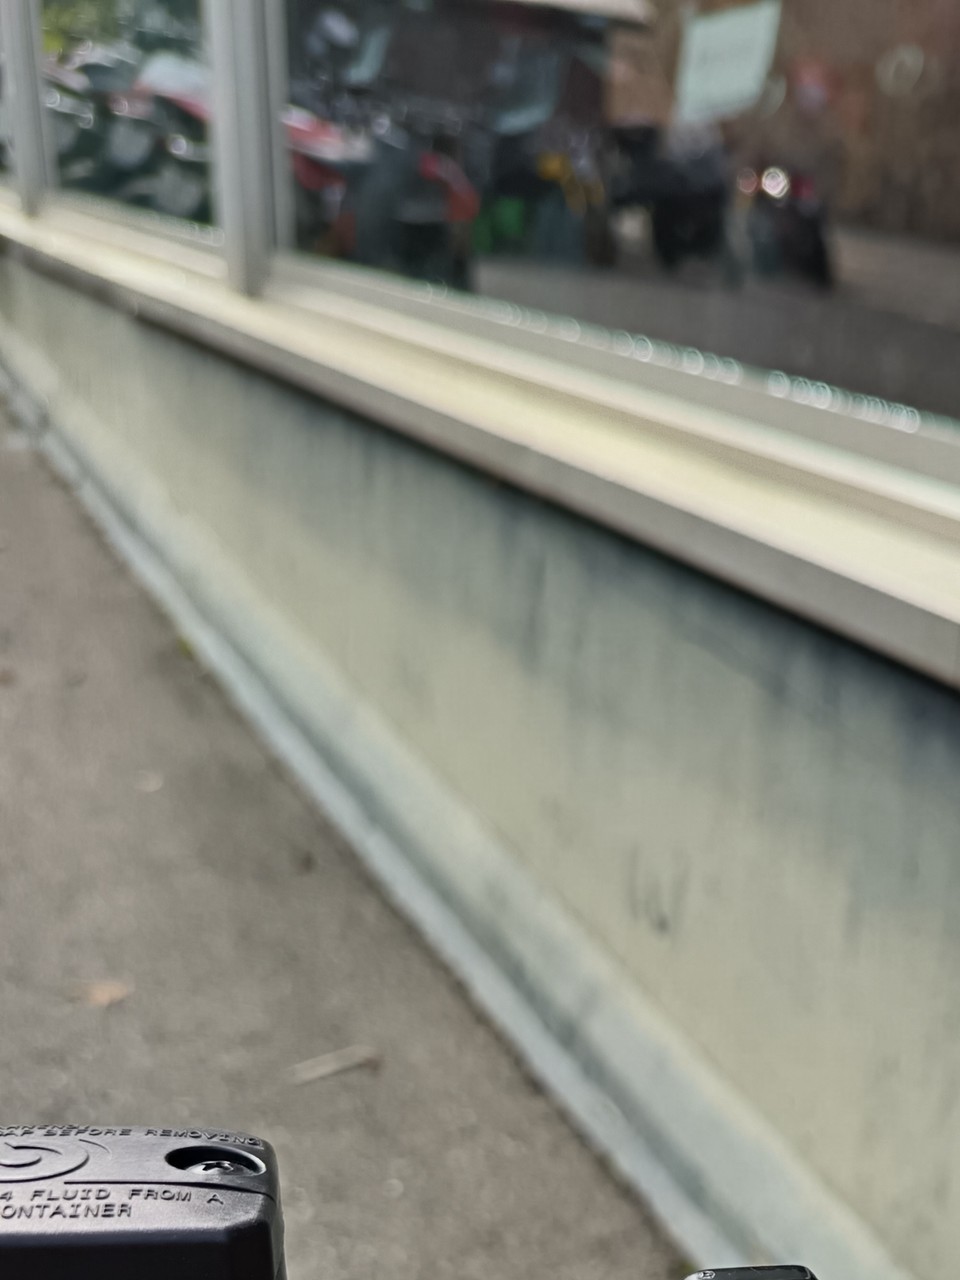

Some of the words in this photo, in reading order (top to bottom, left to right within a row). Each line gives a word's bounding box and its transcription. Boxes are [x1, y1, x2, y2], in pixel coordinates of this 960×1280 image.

[44, 1128, 132, 1137] BEFORE
[30, 1188, 111, 1202] FLUID
[128, 1188, 192, 1202] FROM
[206, 1193, 224, 1205] A
[1, 1203, 132, 1219] ONTAINER
